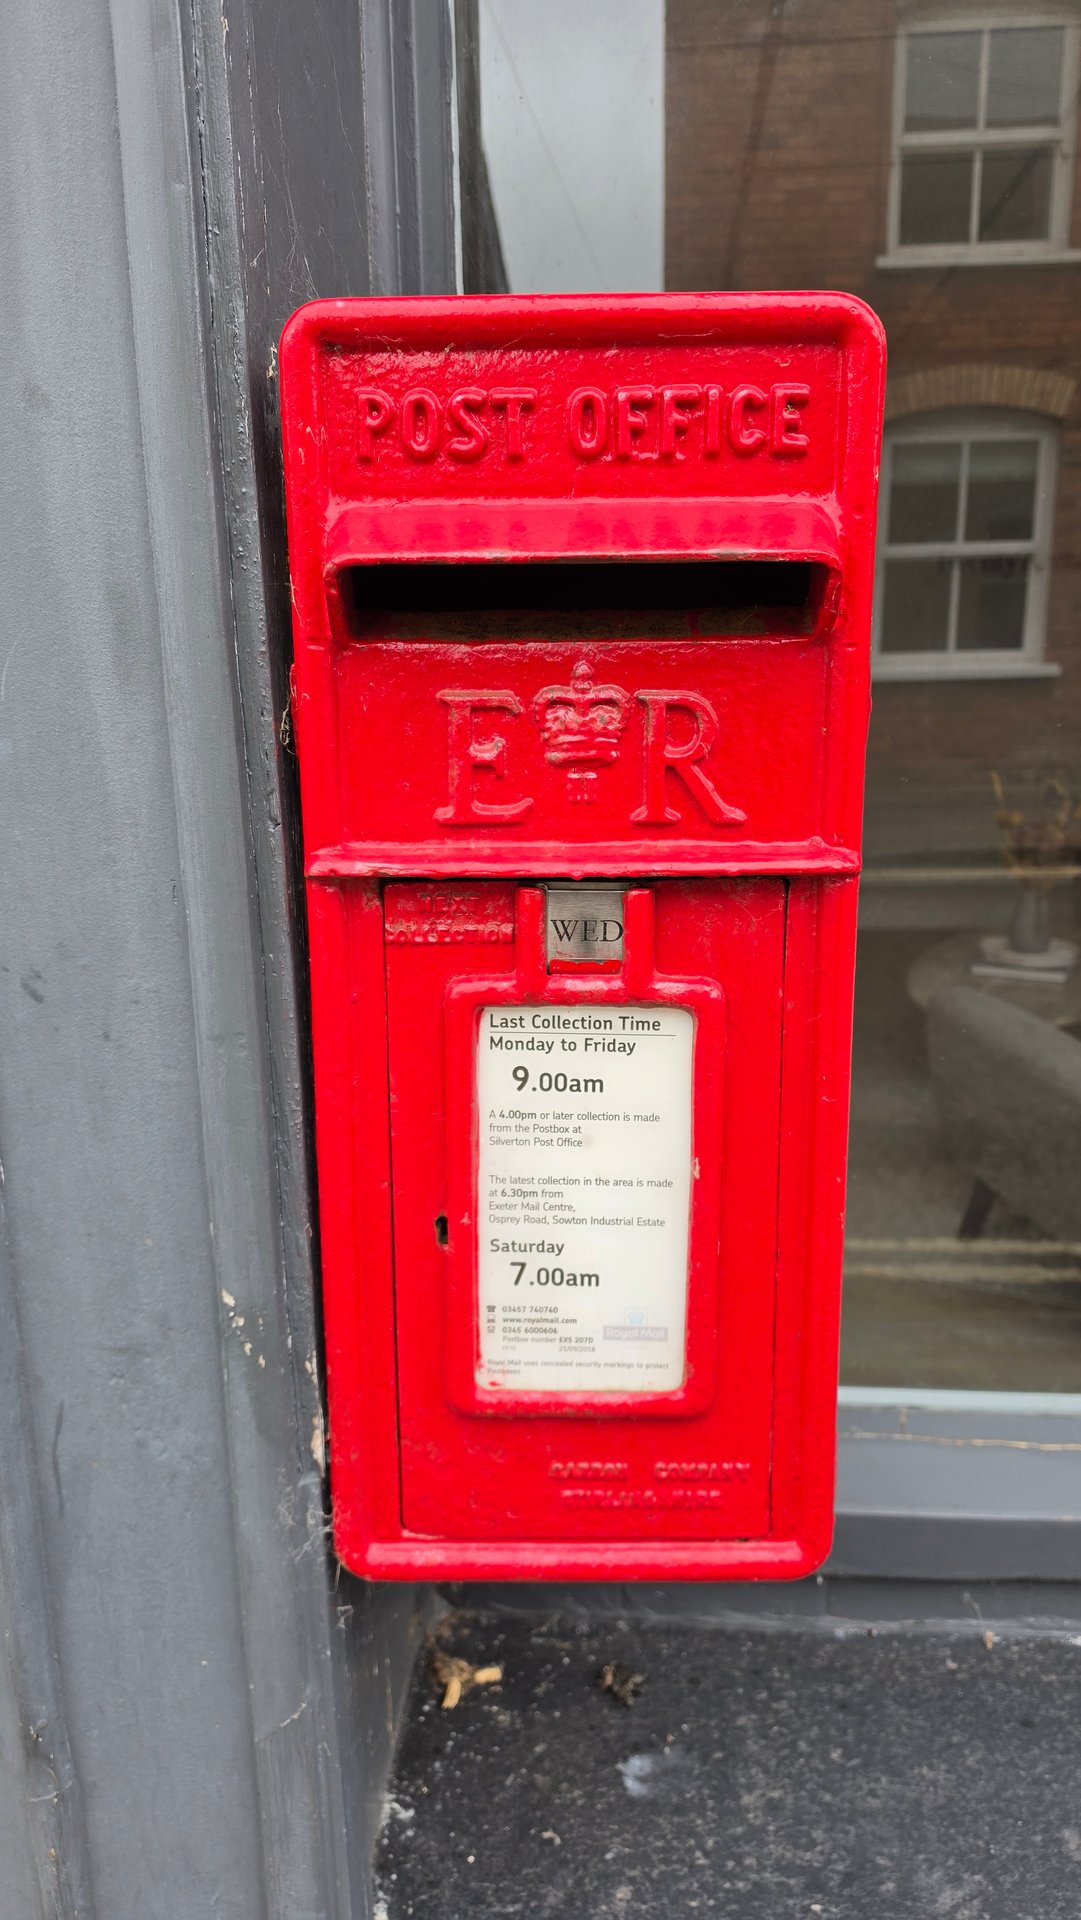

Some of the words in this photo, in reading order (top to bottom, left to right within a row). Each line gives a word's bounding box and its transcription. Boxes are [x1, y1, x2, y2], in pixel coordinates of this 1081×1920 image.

[355, 386, 538, 464] POST
[568, 382, 811, 460] OFFICE
[433, 689, 534, 827] E
[630, 689, 749, 827] R
[550, 918, 624, 943] WED
[490, 1014, 525, 1029] Last
[532, 1014, 613, 1031] Collection
[619, 1016, 661, 1031] Time
[489, 1036, 554, 1054] Monday
[561, 1038, 577, 1052] to
[584, 1038, 636, 1056] Friday
[512, 1065, 604, 1093] 9.00am
[489, 1110, 497, 1119] A
[499, 1110, 537, 1121] 4.00pm
[540, 1112, 550, 1120] or
[553, 1111, 574, 1121] later
[577, 1111, 620, 1122] collection
[623, 1112, 630, 1122] is
[633, 1112, 661, 1122] made
[489, 1123, 512, 1133] from
[514, 1124, 530, 1133] the
[533, 1124, 570, 1134] Postbox
[572, 1125, 582, 1134] at
[489, 1136, 530, 1147] Silverton
[534, 1137, 554, 1147] Post
[556, 1138, 583, 1148] Office
[489, 1175, 507, 1185] The
[509, 1175, 535, 1186] latest
[537, 1176, 580, 1186] collection
[583, 1177, 592, 1186] in
[595, 1177, 611, 1187] the
[613, 1179, 634, 1187] area
[636, 1178, 644, 1187] is
[647, 1179, 674, 1188] made
[489, 1189, 498, 1197] at
[501, 1188, 539, 1200] 6.30pm
[541, 1189, 564, 1199] from
[489, 1201, 518, 1211] Exeter
[521, 1202, 540, 1211] Mail
[543, 1202, 576, 1213] Centre,
[489, 1214, 521, 1226] Osprey
[523, 1214, 550, 1226] Road,
[552, 1215, 588, 1225] Sowton
[590, 1216, 634, 1226] Industrial
[637, 1217, 666, 1227] Estate
[490, 1238, 564, 1256] Saturday
[510, 1261, 600, 1287] 7.00am
[502, 1305, 527, 1313] 03457
[529, 1306, 559, 1314] 740740
[502, 1316, 577, 1325] www.royalmail.com
[502, 1326, 521, 1334] 0345
[607, 1327, 638, 1340] Royal
[640, 1328, 666, 1339] Mail
[502, 1335, 529, 1343] Postbox
[487, 1358, 506, 1367] Royal
[540, 1360, 574, 1368] concealed
[575, 1360, 602, 1369] security
[603, 1361, 634, 1369] markings
[645, 1362, 669, 1370] protect
